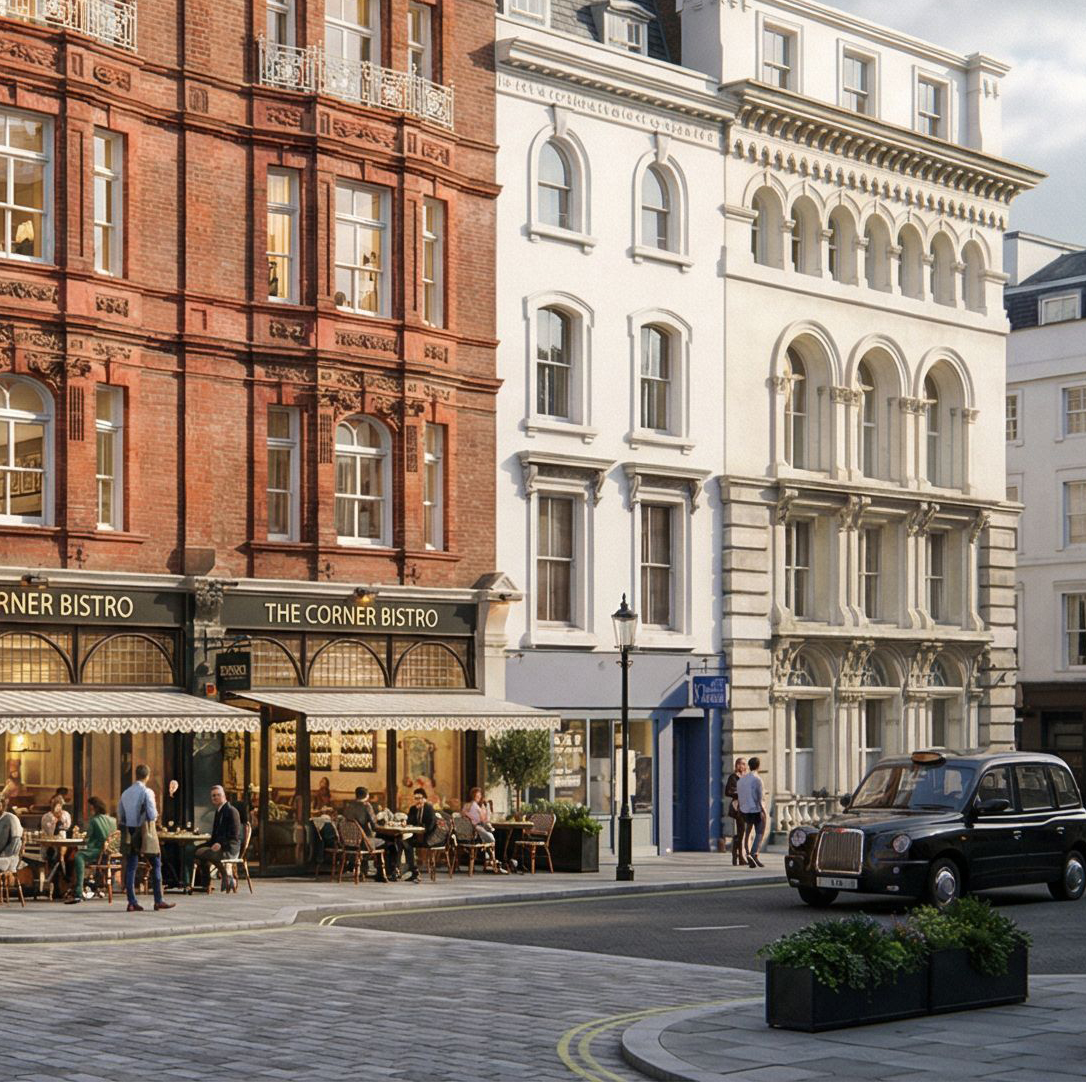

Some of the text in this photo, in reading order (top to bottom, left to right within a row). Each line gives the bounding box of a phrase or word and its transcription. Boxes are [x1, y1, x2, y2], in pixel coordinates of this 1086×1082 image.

[60, 593, 134, 618] BISTRO
[265, 603, 438, 628] THE CORNER BISTRO
